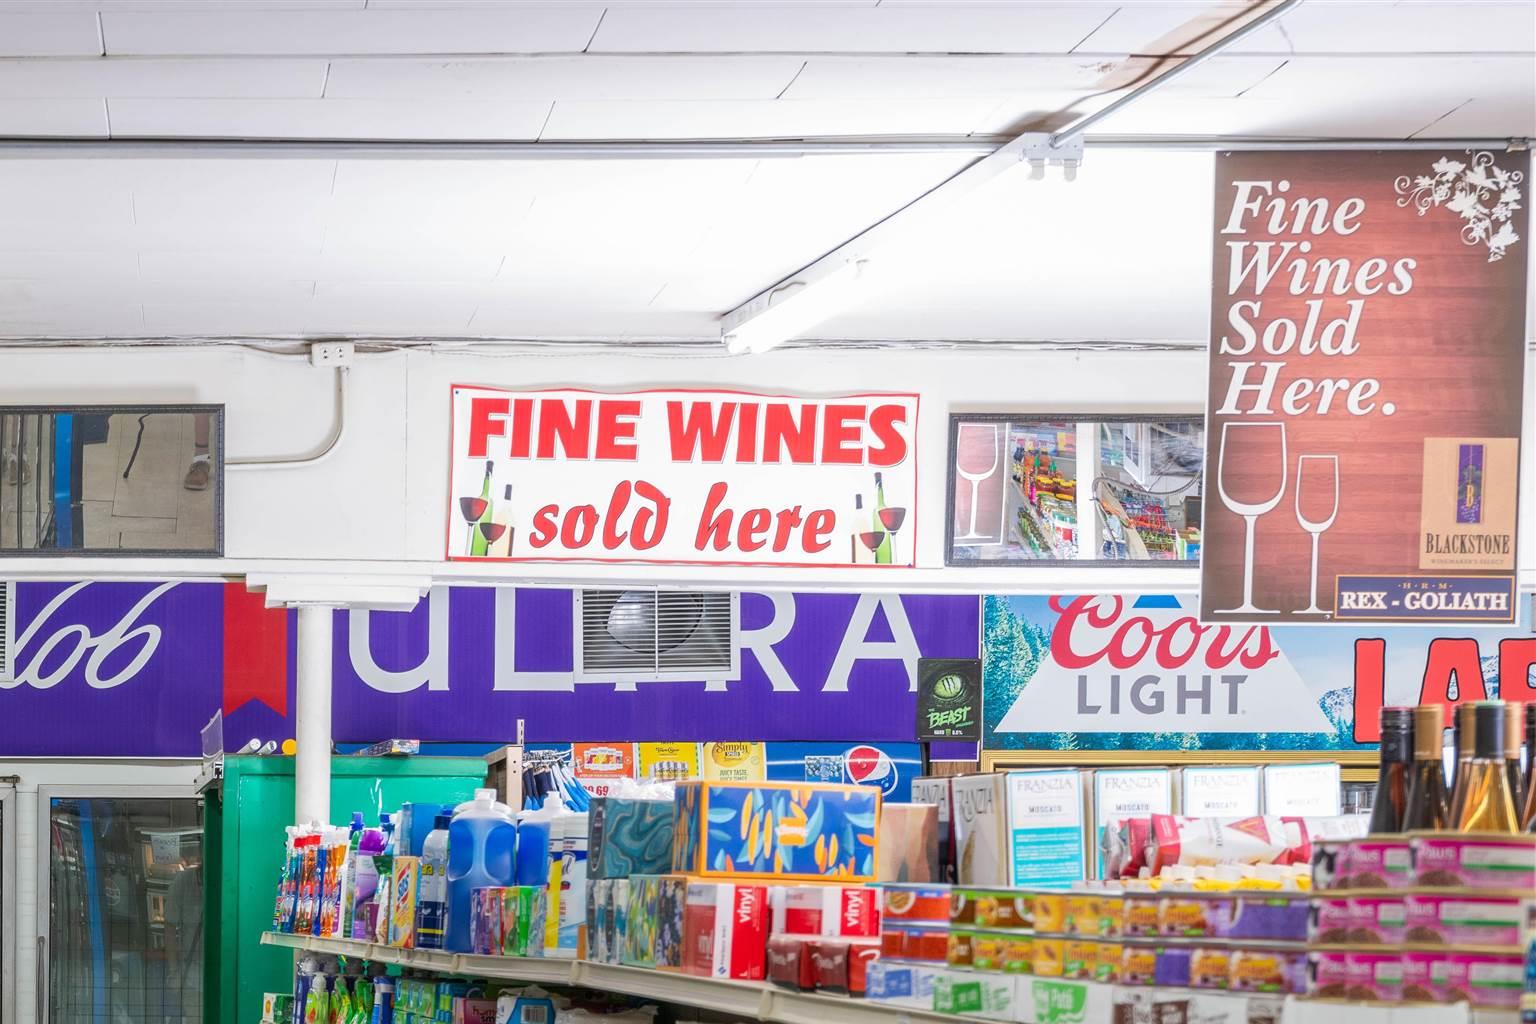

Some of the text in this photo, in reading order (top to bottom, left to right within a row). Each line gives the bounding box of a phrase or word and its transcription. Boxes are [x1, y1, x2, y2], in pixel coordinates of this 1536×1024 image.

[1221, 179, 1366, 237] Fine
[1224, 240, 1418, 297] Wines
[1219, 299, 1365, 357] Sold
[1216, 360, 1397, 417] Here.
[467, 397, 908, 467] FINE WINES
[529, 479, 837, 553] sold here
[1425, 533, 1510, 554] BLACKSTONE
[1340, 591, 1384, 610] REX
[1404, 591, 1508, 610] GOLIATH
[348, 586, 920, 692] ULRA
[1049, 595, 1279, 669] Coors
[926, 706, 972, 729] BEAST
[1076, 675, 1248, 715] LIGHT
[1017, 778, 1073, 793] FRANZIA
[1104, 777, 1160, 792] FRANZIA
[737, 887, 755, 924] vinyl
[844, 889, 864, 927] vinyl
